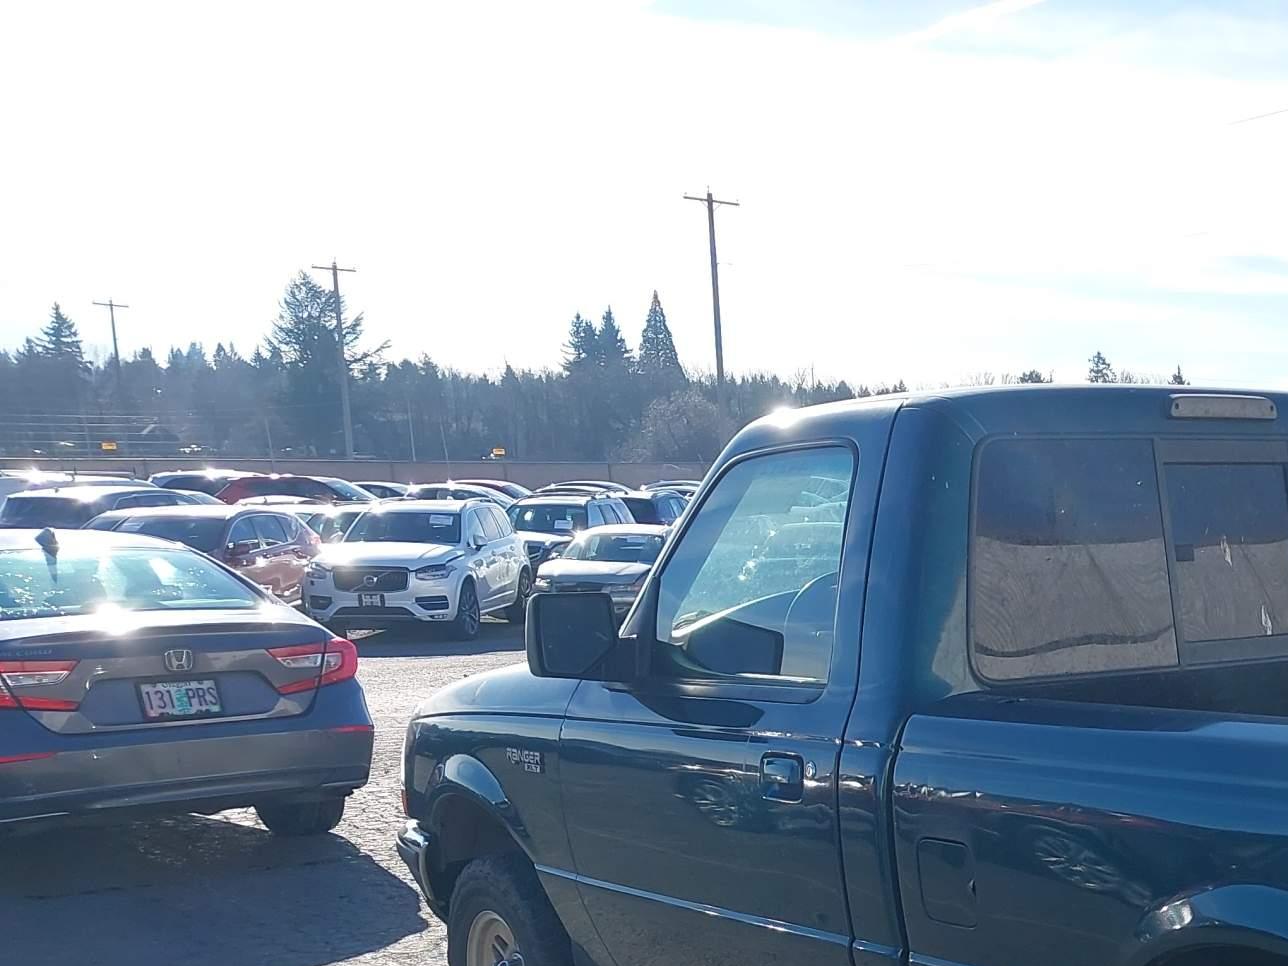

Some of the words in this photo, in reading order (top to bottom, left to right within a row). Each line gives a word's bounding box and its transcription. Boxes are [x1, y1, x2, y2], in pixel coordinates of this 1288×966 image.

[144, 689, 176, 711] 131
[185, 687, 218, 708] PRS
[505, 747, 541, 765] RANGER
